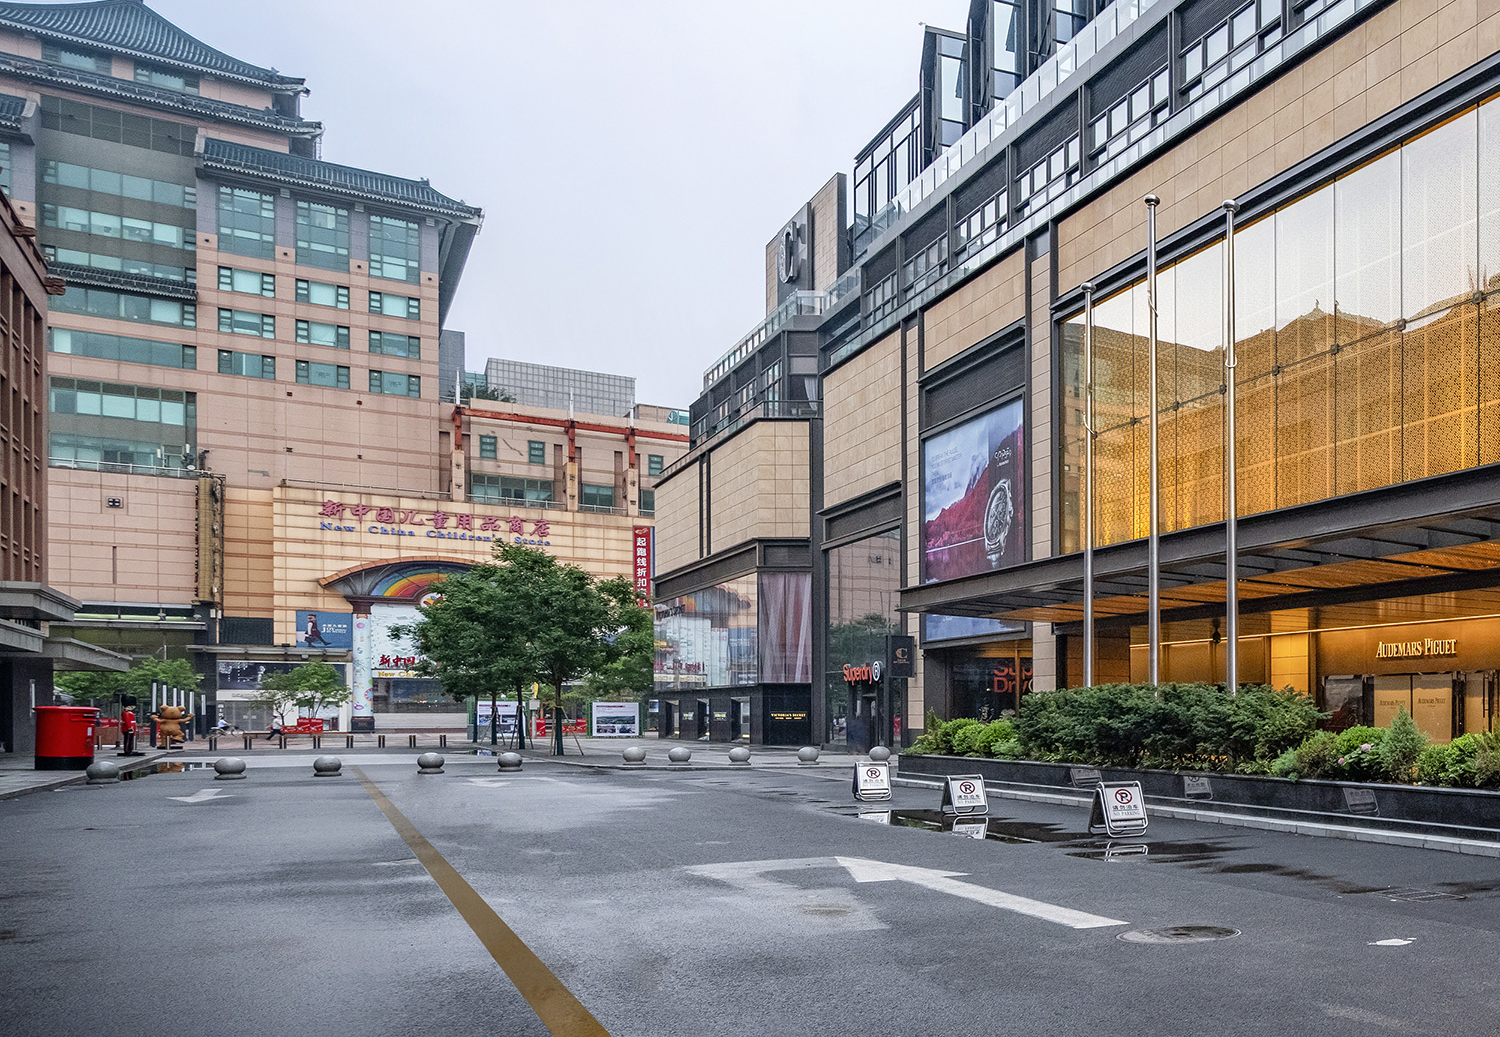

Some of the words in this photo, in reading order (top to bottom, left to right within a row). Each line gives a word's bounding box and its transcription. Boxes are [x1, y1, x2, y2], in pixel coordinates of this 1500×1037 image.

[319, 499, 551, 538] 新中国儿童用品商店
[320, 522, 355, 532] New
[368, 525, 415, 537] China
[514, 536, 551, 546] Store
[636, 537, 648, 608] 起跑线折扣
[1375, 641, 1423, 658] AUDEMARS
[1424, 638, 1457, 656] PIGUET
